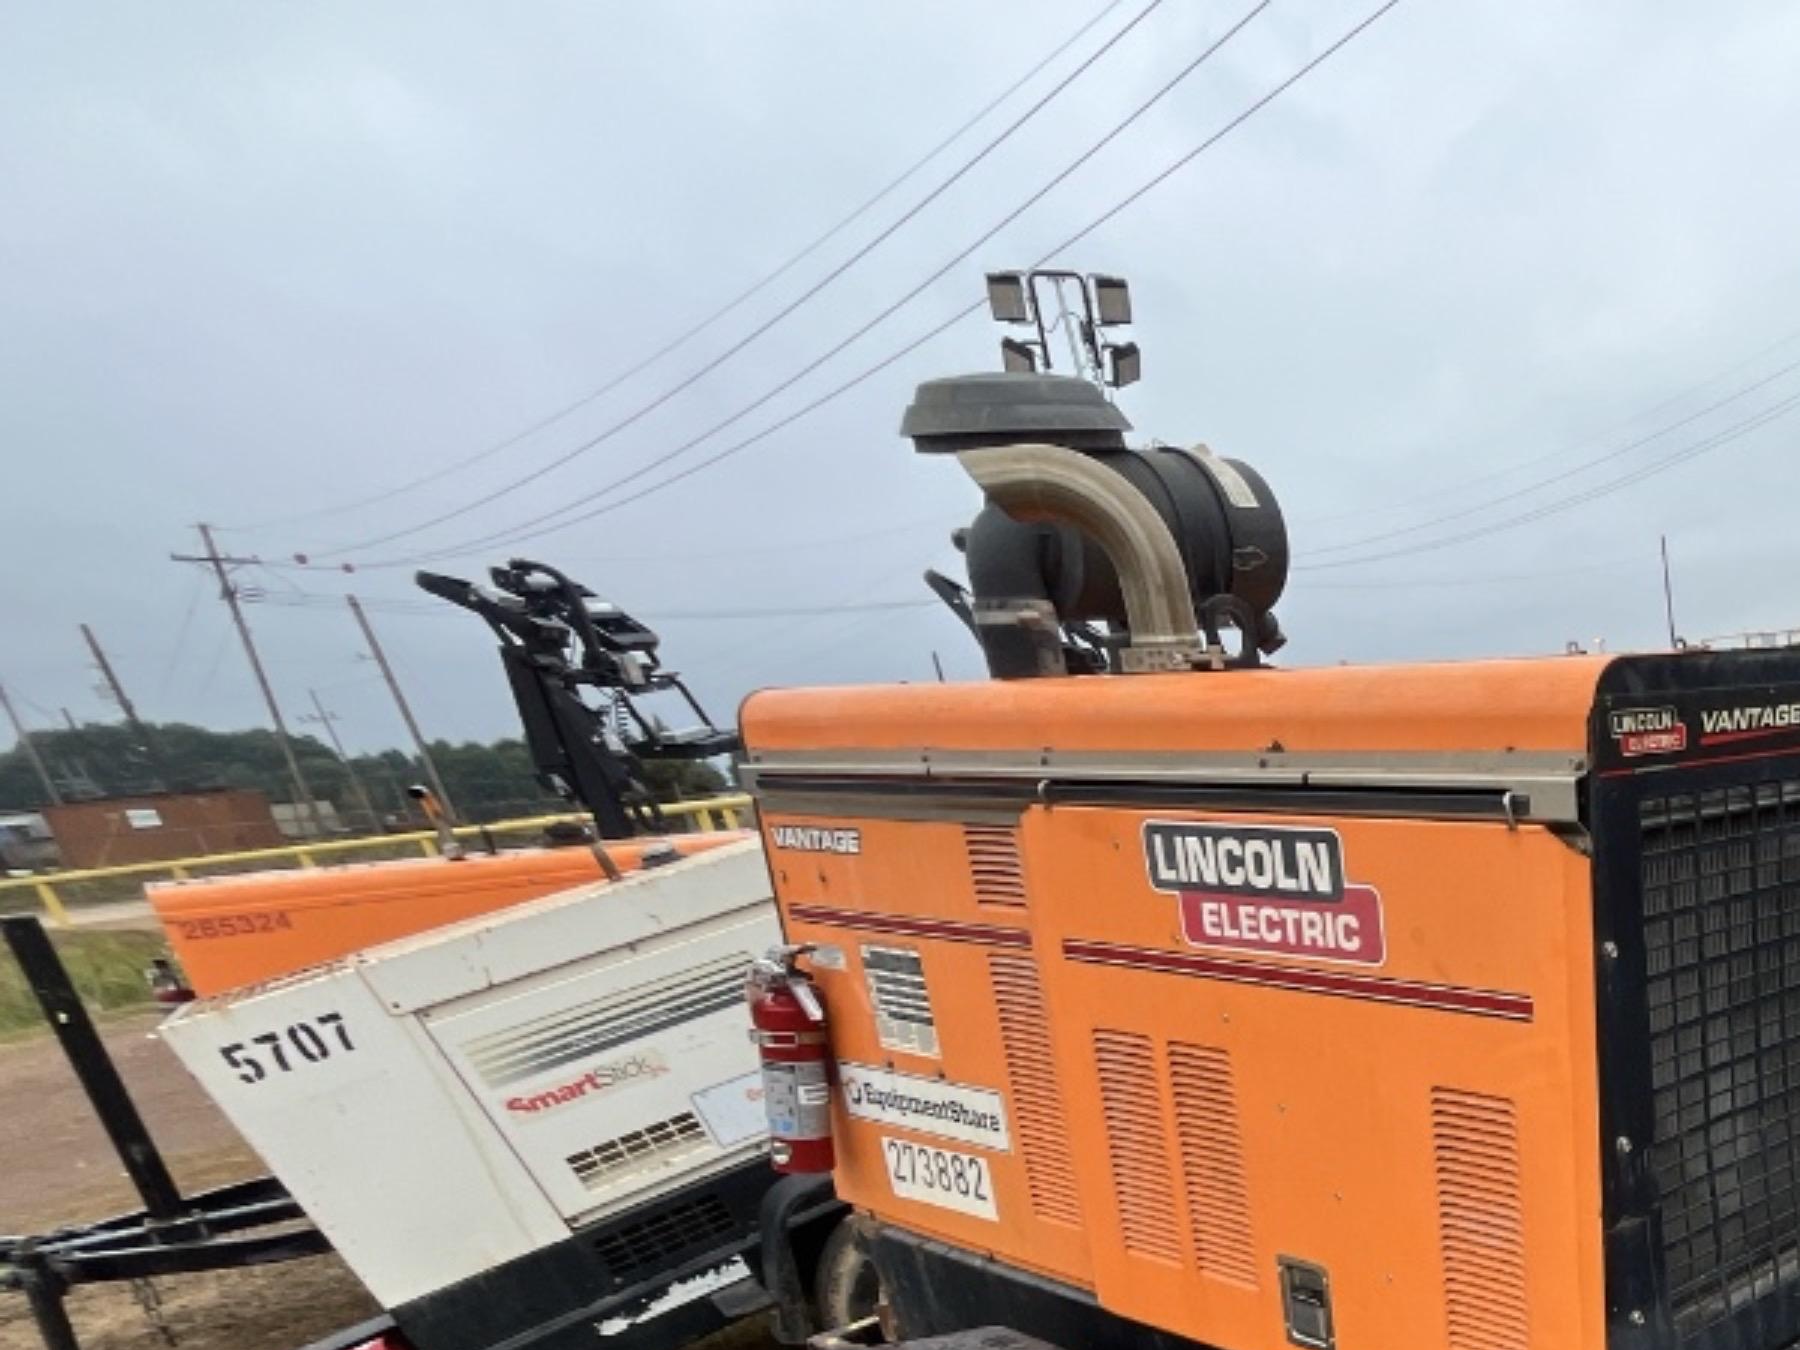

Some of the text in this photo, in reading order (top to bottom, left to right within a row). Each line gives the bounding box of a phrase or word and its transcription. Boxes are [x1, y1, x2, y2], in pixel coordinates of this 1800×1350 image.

[1612, 709, 1673, 734] LINCOLN
[769, 826, 860, 854] VANTAGE
[1153, 833, 1334, 895] LINCOLN
[1201, 901, 1361, 952] ELECTRIC
[219, 1012, 356, 1084] 5707
[863, 1081, 1001, 1132] EquipmentShare
[886, 1140, 989, 1201] 273882
